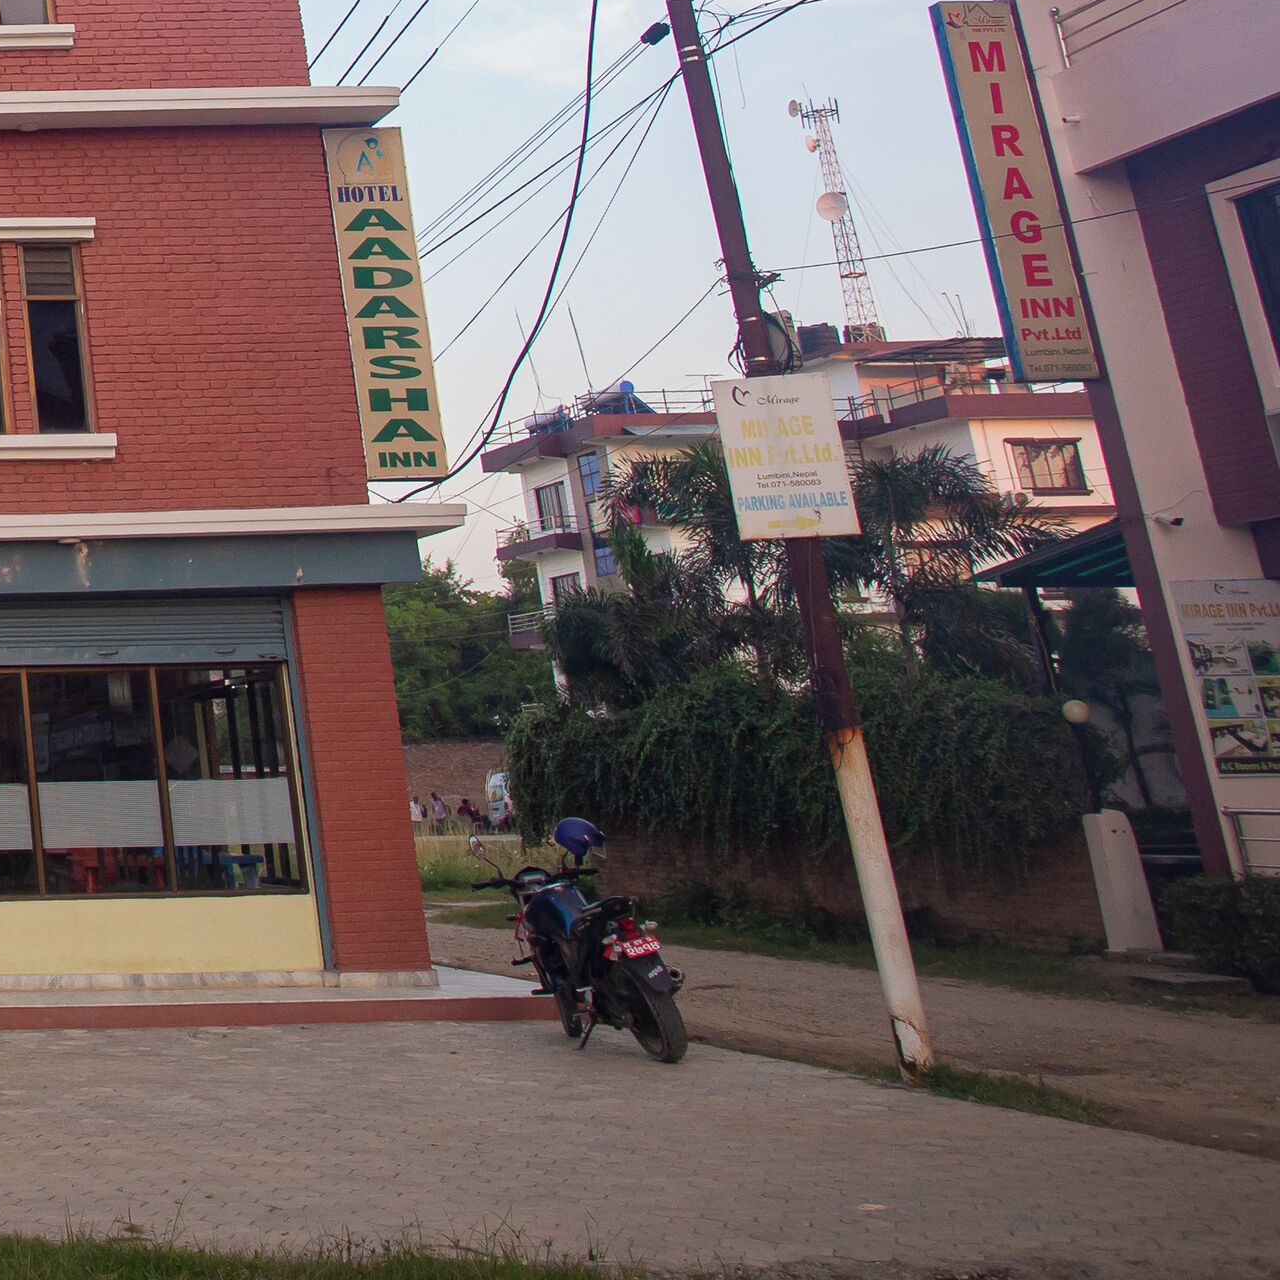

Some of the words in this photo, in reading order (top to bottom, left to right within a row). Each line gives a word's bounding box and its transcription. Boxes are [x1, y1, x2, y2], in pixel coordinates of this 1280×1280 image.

[966, 40, 1053, 288] MIRAGE
[336, 185, 404, 203] HOTEL
[1019, 296, 1076, 319] INN
[343, 207, 439, 443] AADARSHA
[1021, 326, 1083, 341] Pvt.Ltd
[756, 394, 801, 407] Mirage
[739, 414, 816, 439] MIAGE
[378, 451, 437, 469] INN
[728, 446, 762, 468] INN
[756, 470, 818, 481] Lumbini,Nepal
[737, 494, 785, 512] PARKING
[789, 490, 849, 509] AVAILABLE
